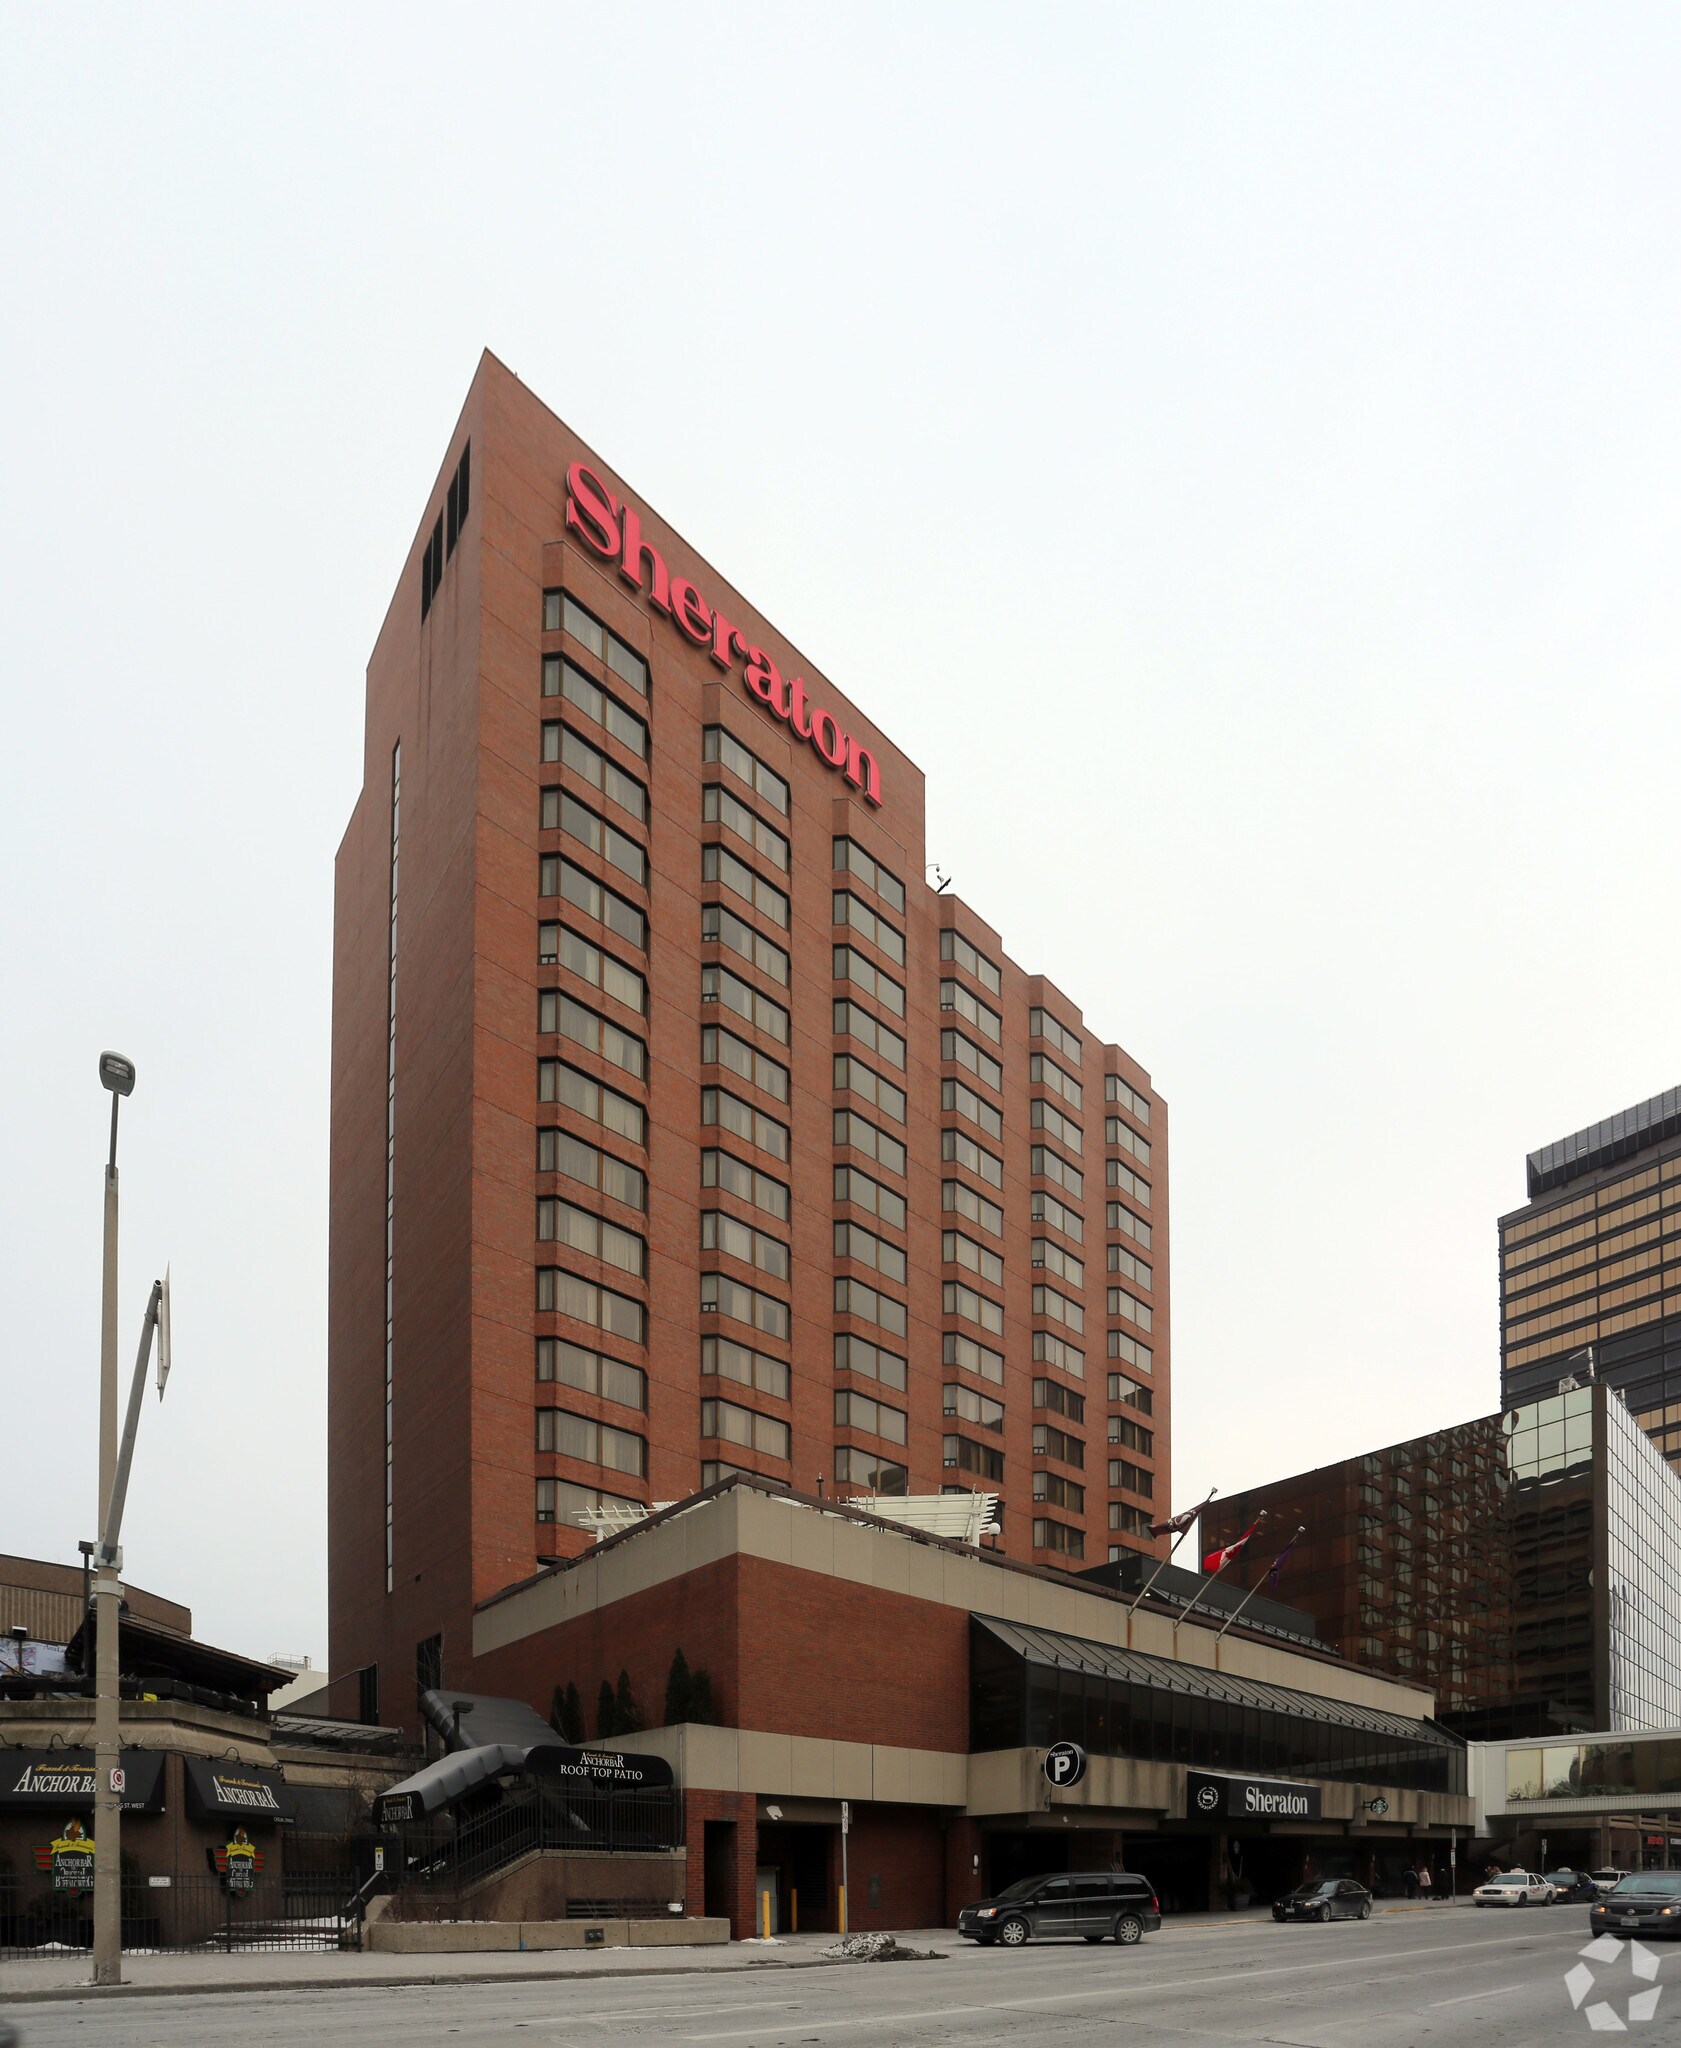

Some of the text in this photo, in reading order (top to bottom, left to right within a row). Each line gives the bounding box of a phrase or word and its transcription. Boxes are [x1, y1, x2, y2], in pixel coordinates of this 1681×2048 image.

[566, 461, 882, 809] Sheraton
[1050, 1750, 1074, 1758] Sheraton
[13, 1765, 96, 1792] ANCHOR BA
[560, 1764, 643, 1780] ROOF TOP PATIO
[1054, 1756, 1070, 1781] P
[1202, 1790, 1214, 1805] S
[1245, 1786, 1308, 1815] Sheraton
